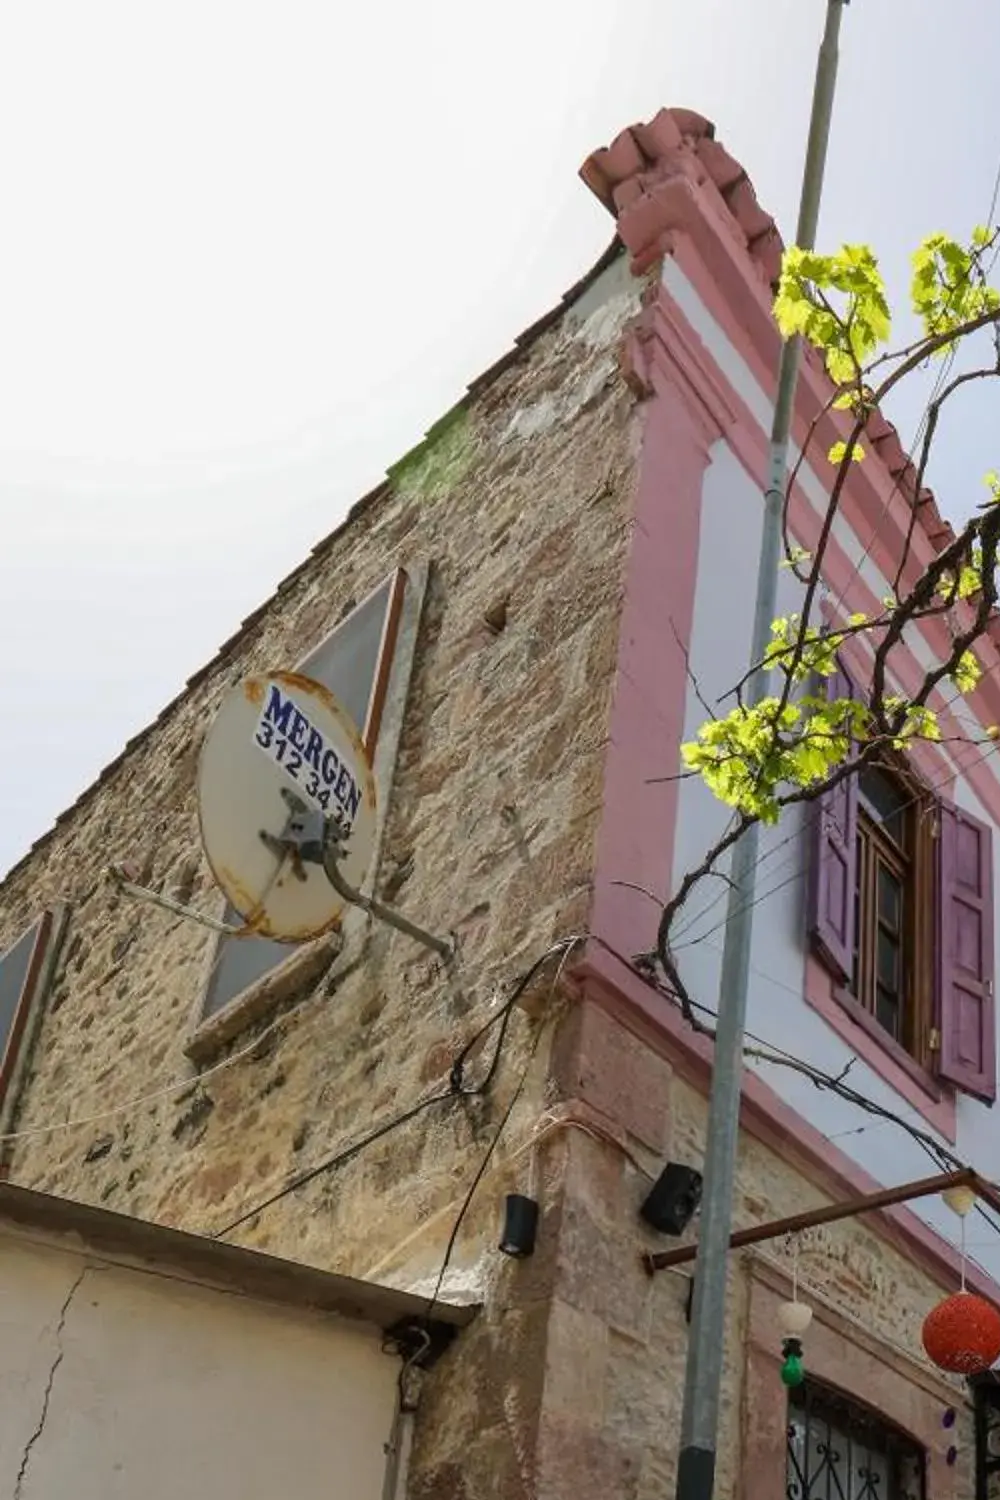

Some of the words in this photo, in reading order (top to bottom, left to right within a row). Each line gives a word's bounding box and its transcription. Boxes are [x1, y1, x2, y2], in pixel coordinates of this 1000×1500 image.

[255, 720, 303, 779] 312
[306, 771, 331, 811] 34
[264, 685, 363, 821] MERGEN
